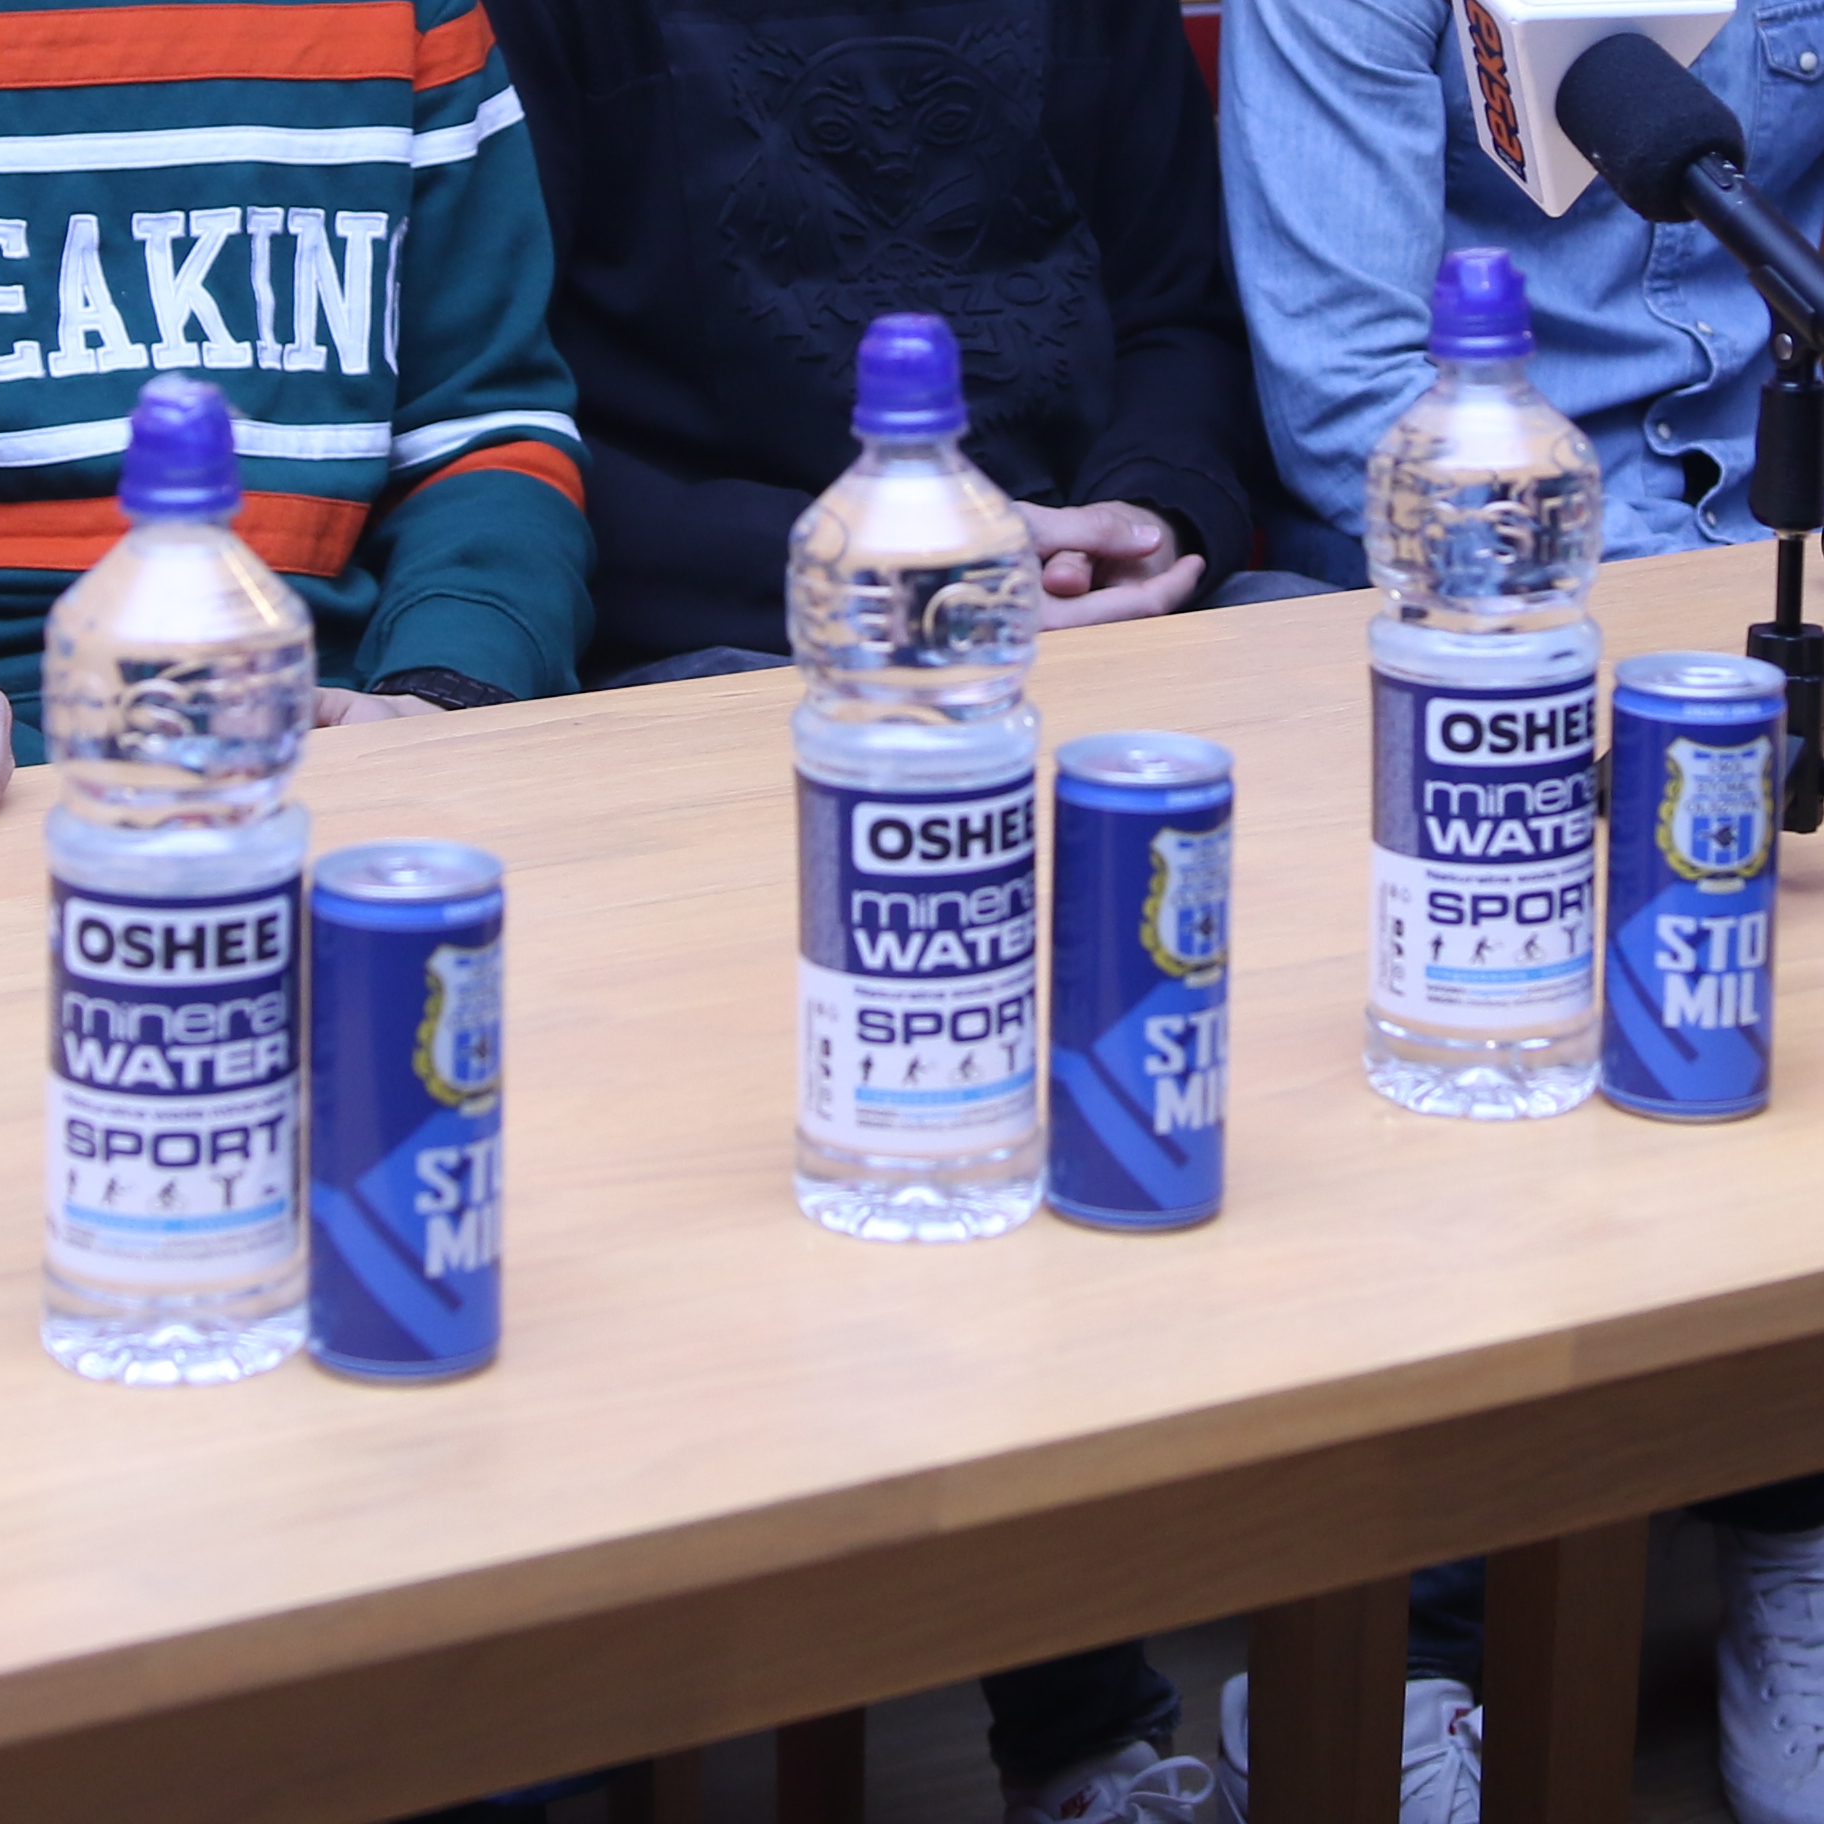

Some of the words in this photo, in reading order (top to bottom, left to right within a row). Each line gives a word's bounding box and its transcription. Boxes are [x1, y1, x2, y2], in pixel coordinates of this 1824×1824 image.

[78, 916, 279, 969] OSHEE
[1655, 911, 1768, 971] STO
[1663, 973, 1760, 1029] MIL
[62, 1032, 290, 1089] WATER
[66, 1113, 284, 1167] SPORT
